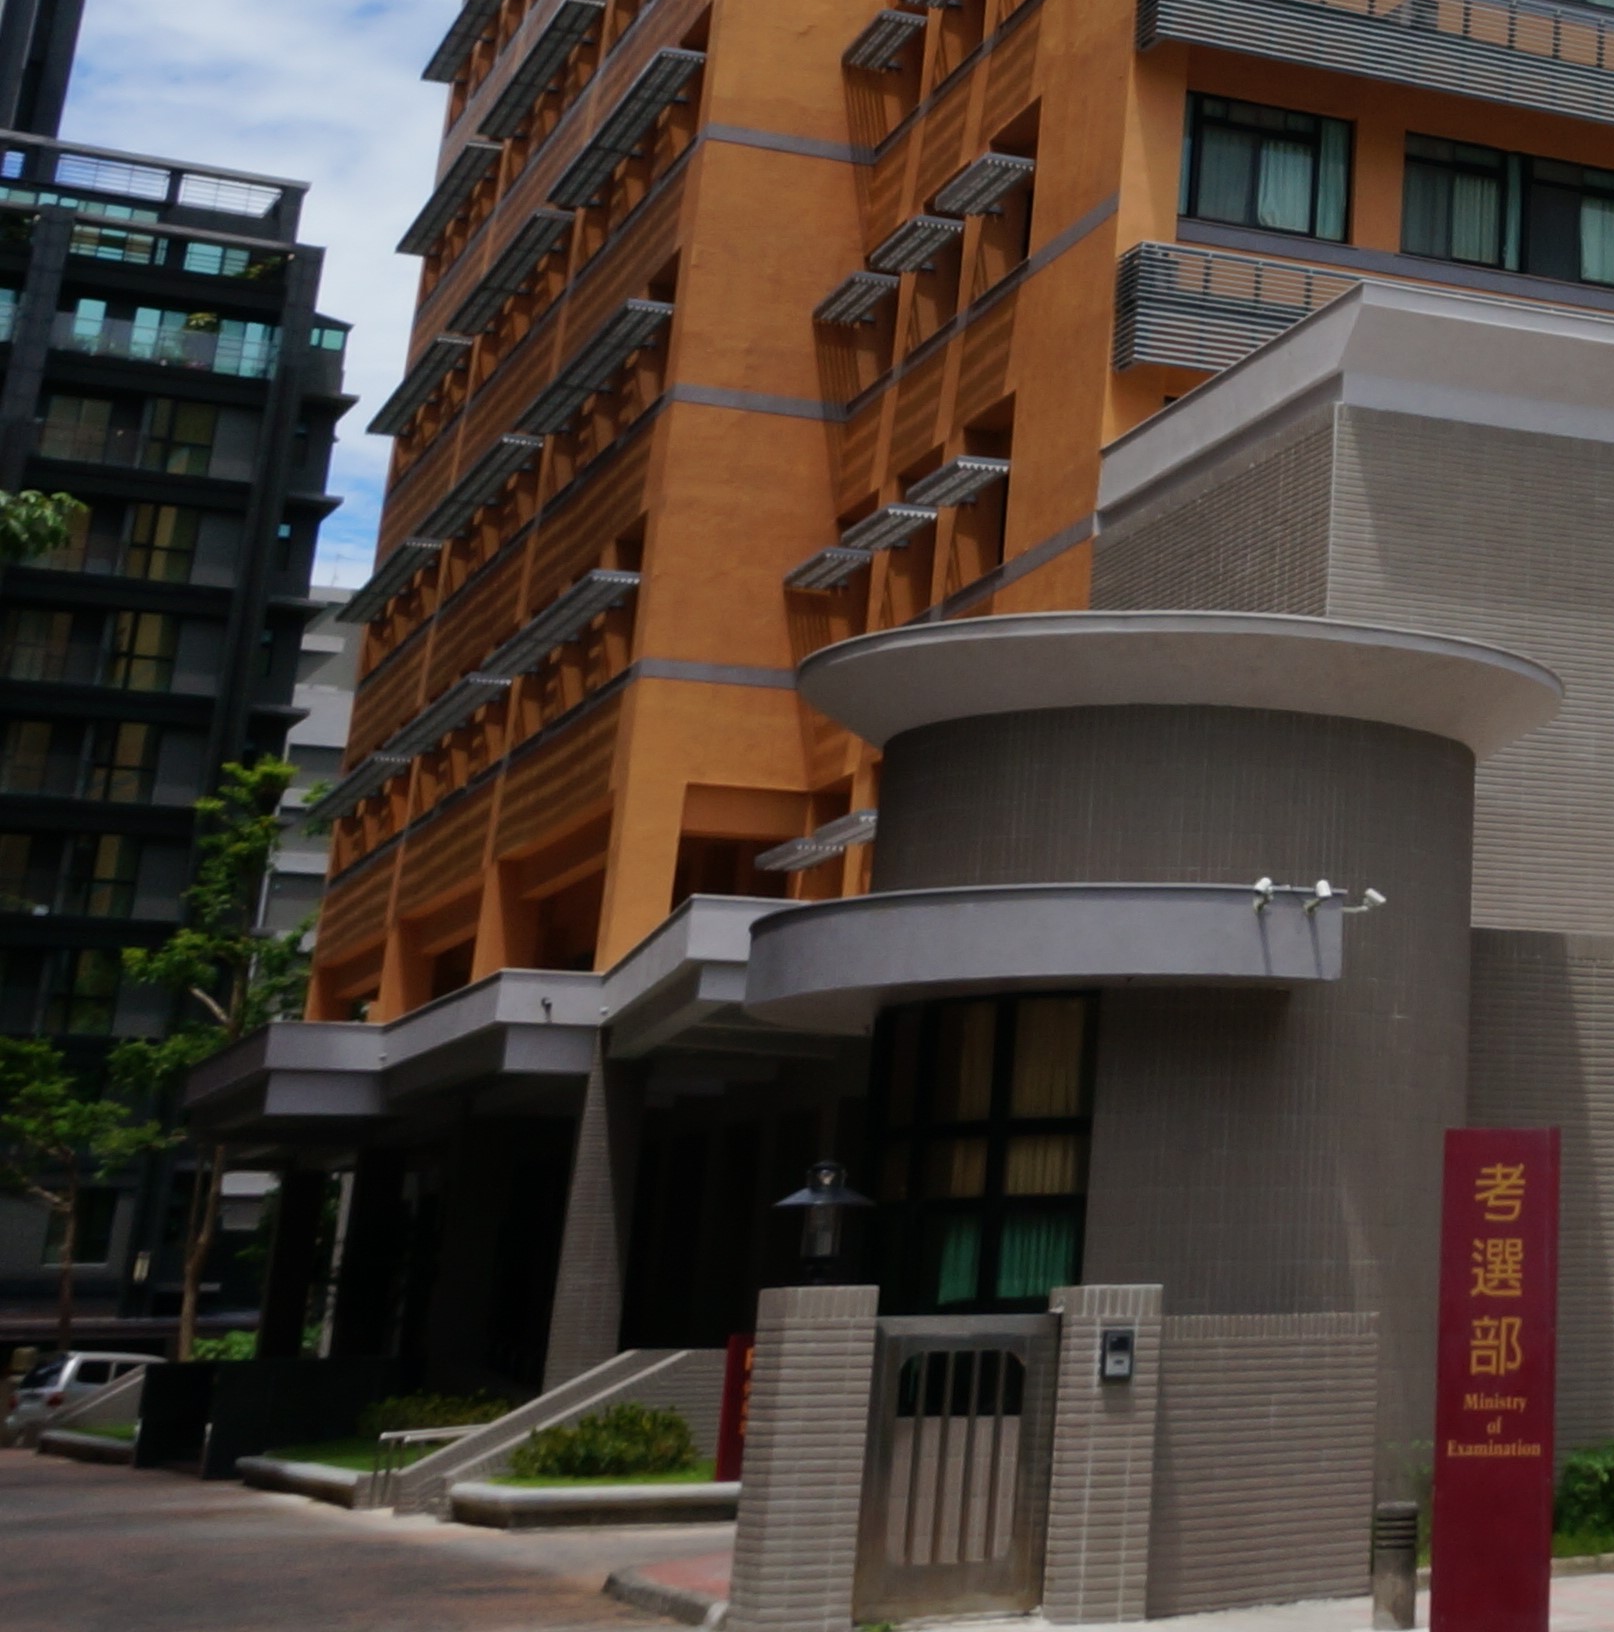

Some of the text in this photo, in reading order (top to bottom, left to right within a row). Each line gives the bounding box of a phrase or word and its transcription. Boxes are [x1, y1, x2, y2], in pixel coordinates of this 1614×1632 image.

[1470, 1161, 1526, 1375] 考選部
[1463, 1393, 1525, 1413] Ministry
[1486, 1417, 1502, 1434] of
[1446, 1440, 1541, 1457] Examination
